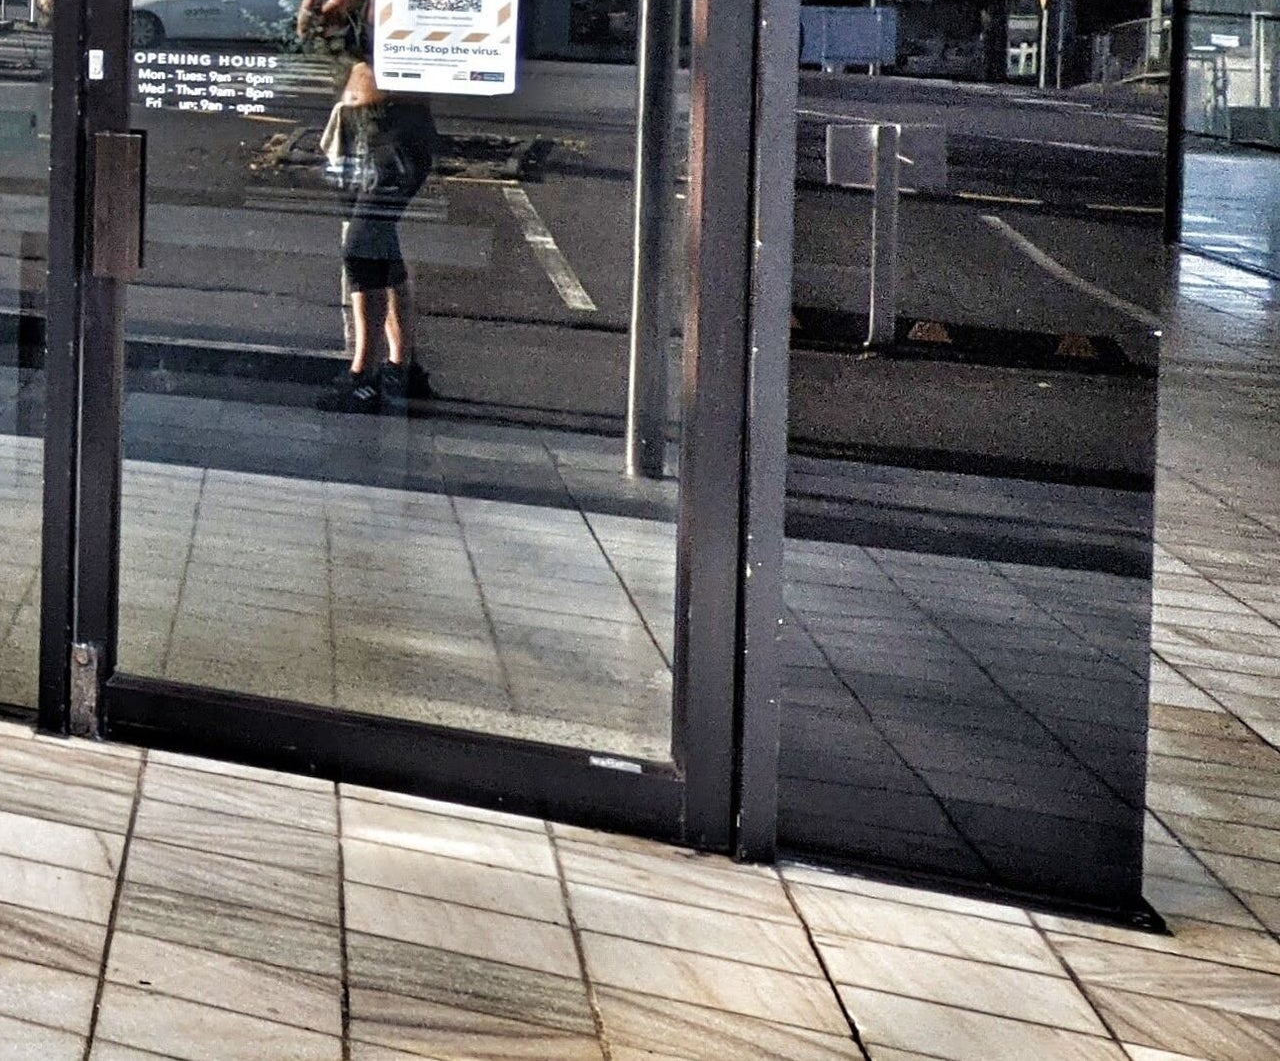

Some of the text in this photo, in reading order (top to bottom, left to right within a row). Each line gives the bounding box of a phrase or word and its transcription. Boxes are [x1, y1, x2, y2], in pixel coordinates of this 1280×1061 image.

[383, 43, 502, 56] Sign-in. Stop the virus.
[134, 52, 278, 69] OPENING HOURS
[138, 68, 166, 80] Mon
[175, 70, 207, 82] Tues:
[245, 73, 274, 86] 6pm
[138, 83, 166, 95] Wed
[209, 85, 236, 97] 9am
[245, 88, 274, 101] 8pm
[146, 97, 163, 109] Fri
